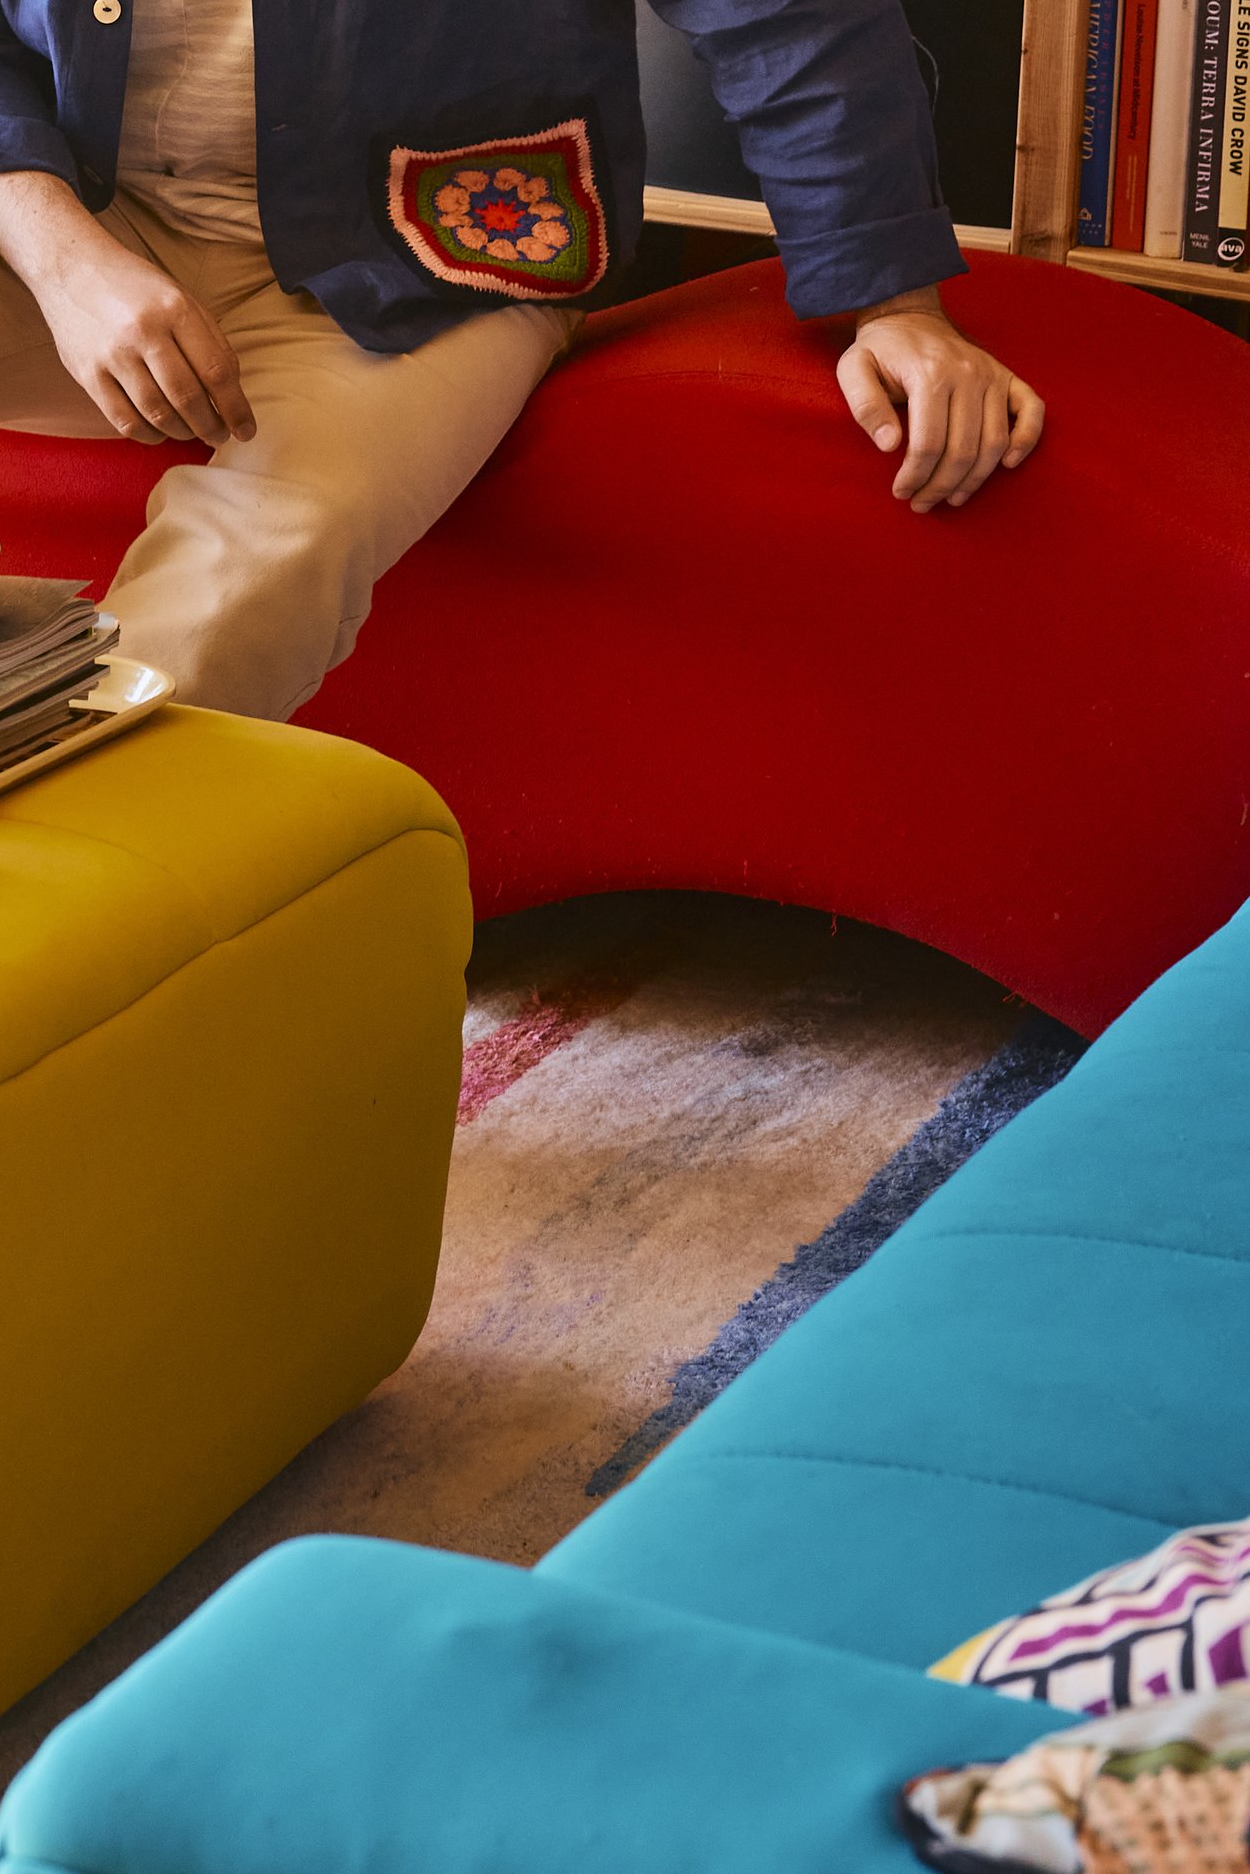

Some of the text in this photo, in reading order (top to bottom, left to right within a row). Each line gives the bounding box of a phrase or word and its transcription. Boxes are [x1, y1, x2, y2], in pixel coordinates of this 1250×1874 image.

[1235, 21, 1250, 70] SIGNS
[1200, 56, 1218, 121] TERRA
[1232, 76, 1247, 122] DAVID
[1195, 128, 1214, 213] INFIRMA
[1229, 128, 1244, 176] CROW
[1189, 232, 1210, 241] MENIL
[1191, 240, 1209, 249] YALE
[1220, 243, 1242, 253] ava
